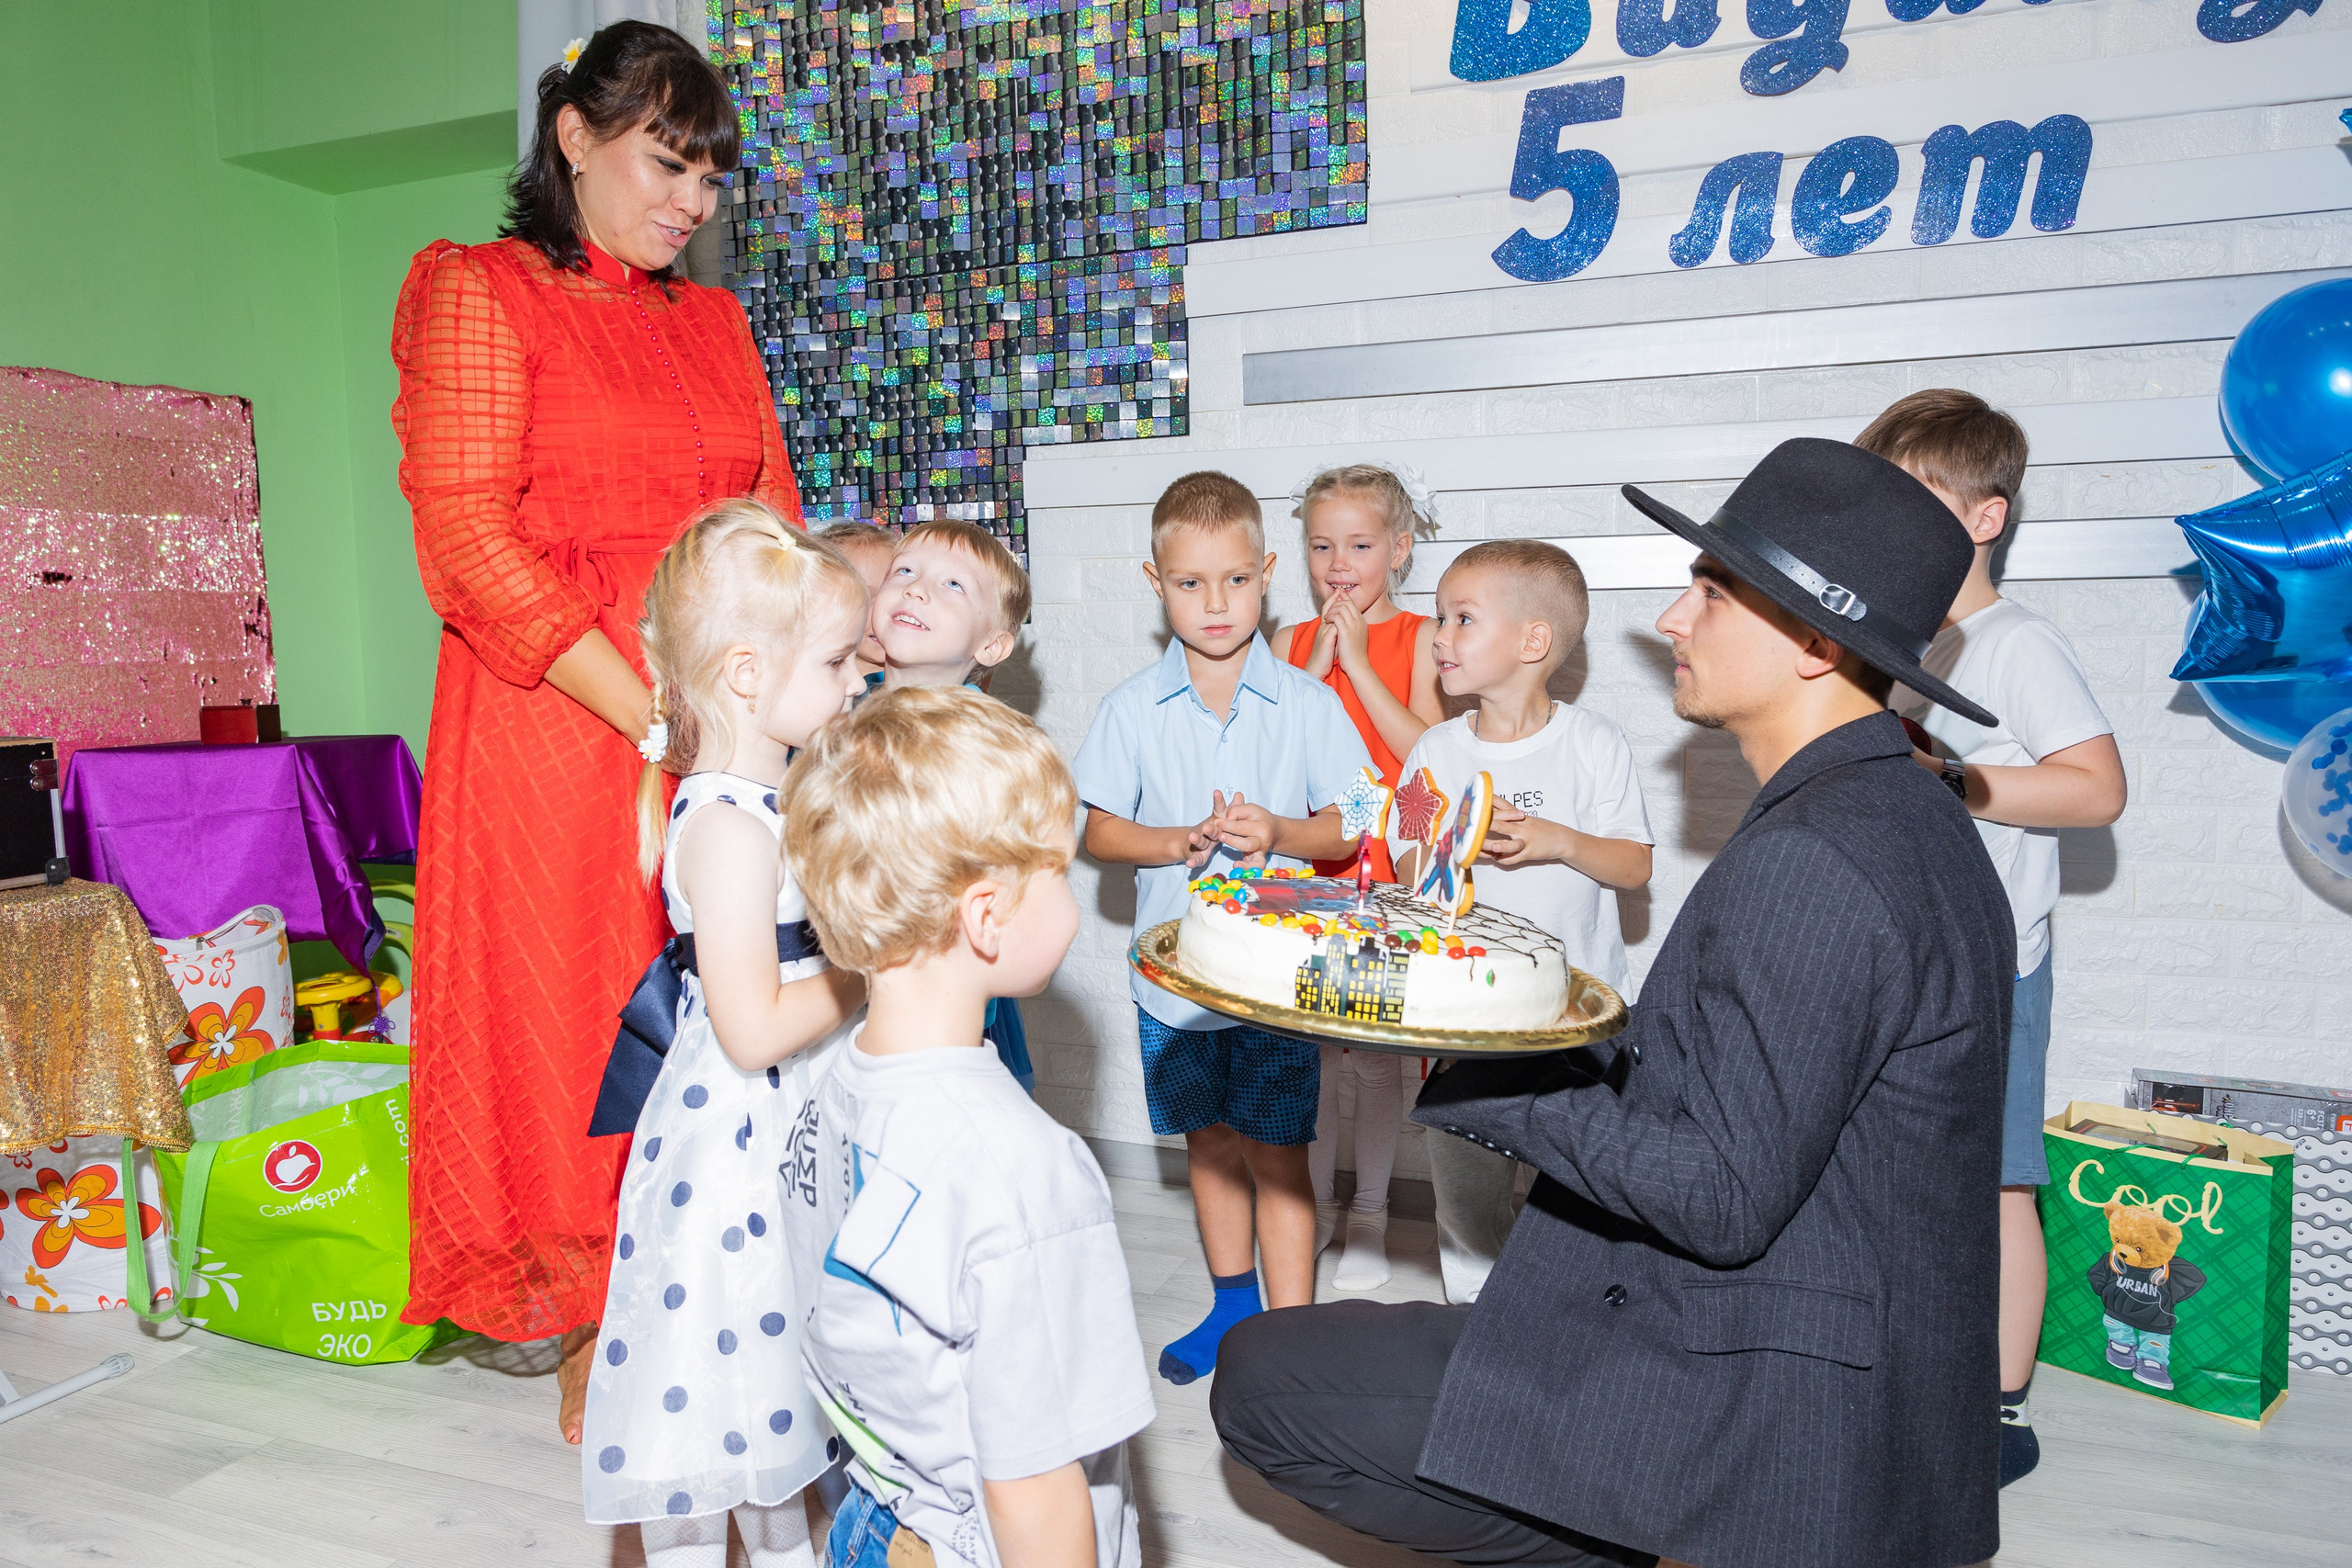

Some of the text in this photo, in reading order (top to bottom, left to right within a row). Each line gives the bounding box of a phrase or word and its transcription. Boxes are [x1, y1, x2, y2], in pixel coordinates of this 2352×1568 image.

[1490, 75, 2093, 283] 5 лет
[2307, 1109, 2316, 1121] 6+
[259, 1185, 355, 1218] Самбери
[2068, 1159, 2224, 1235] Cool
[2116, 1276, 2159, 1297] URBAN
[311, 1299, 388, 1323] БУДЬ
[317, 1333, 372, 1359] ЭКО
